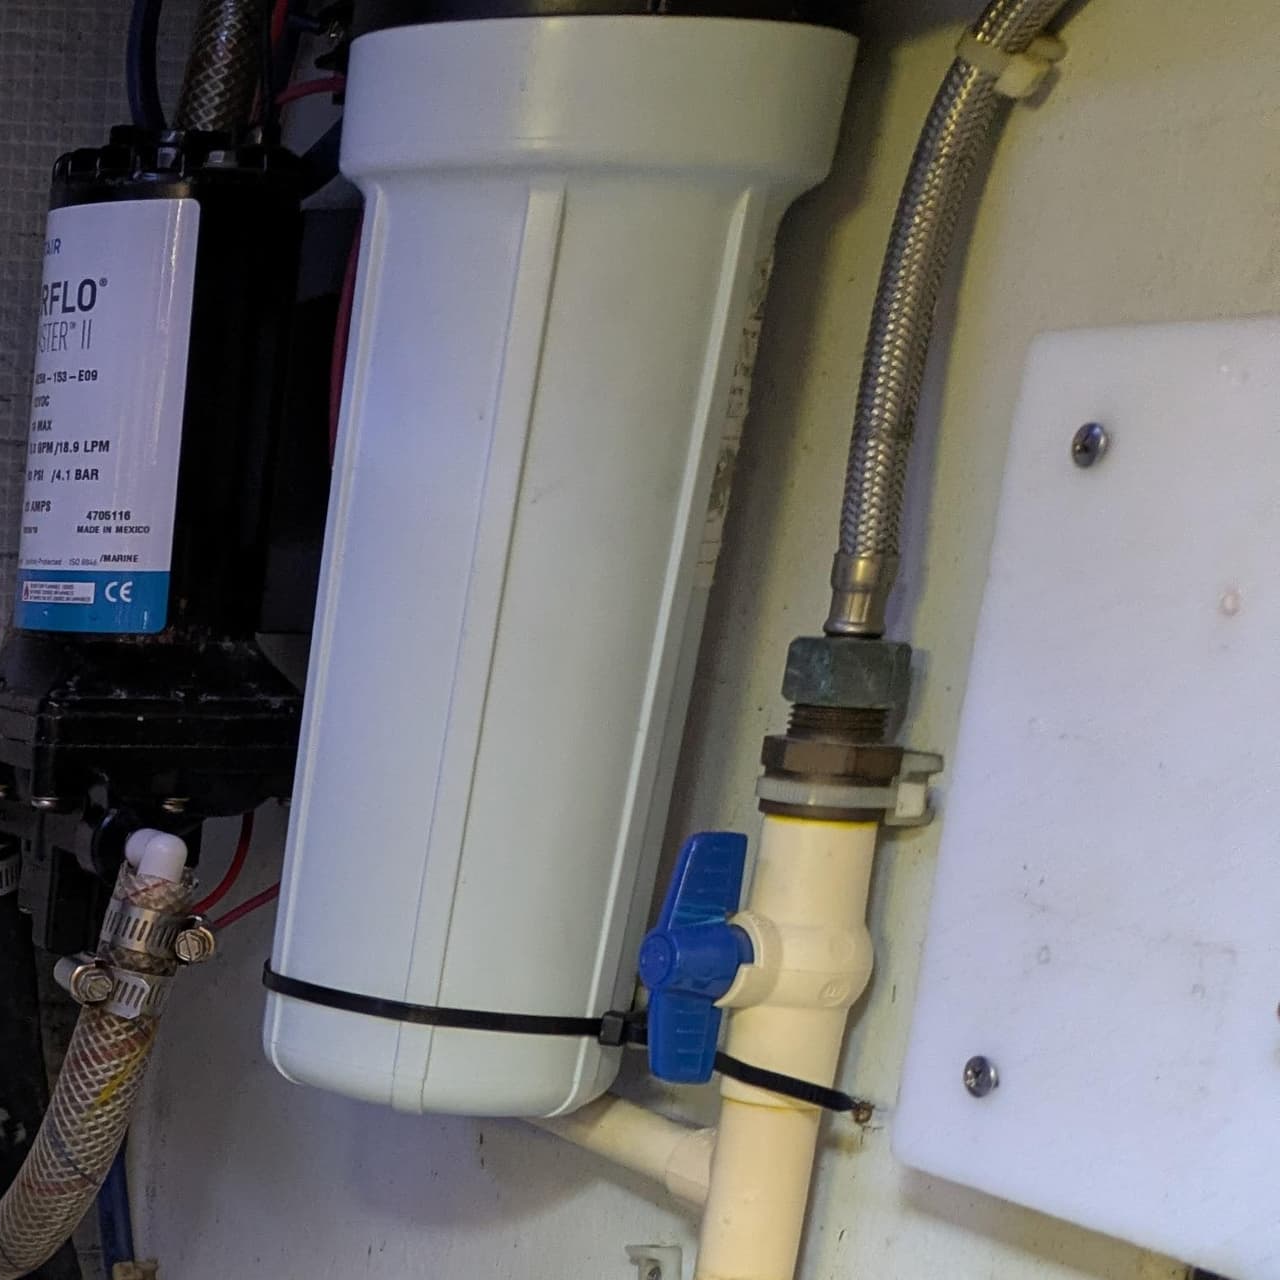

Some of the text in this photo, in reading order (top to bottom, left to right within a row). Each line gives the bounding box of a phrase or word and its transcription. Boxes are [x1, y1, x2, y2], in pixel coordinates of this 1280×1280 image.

[86, 441, 110, 452] LPM
[51, 469, 70, 483] /4.1
[75, 469, 99, 480] BAR
[100, 555, 138, 563] /MARINE
